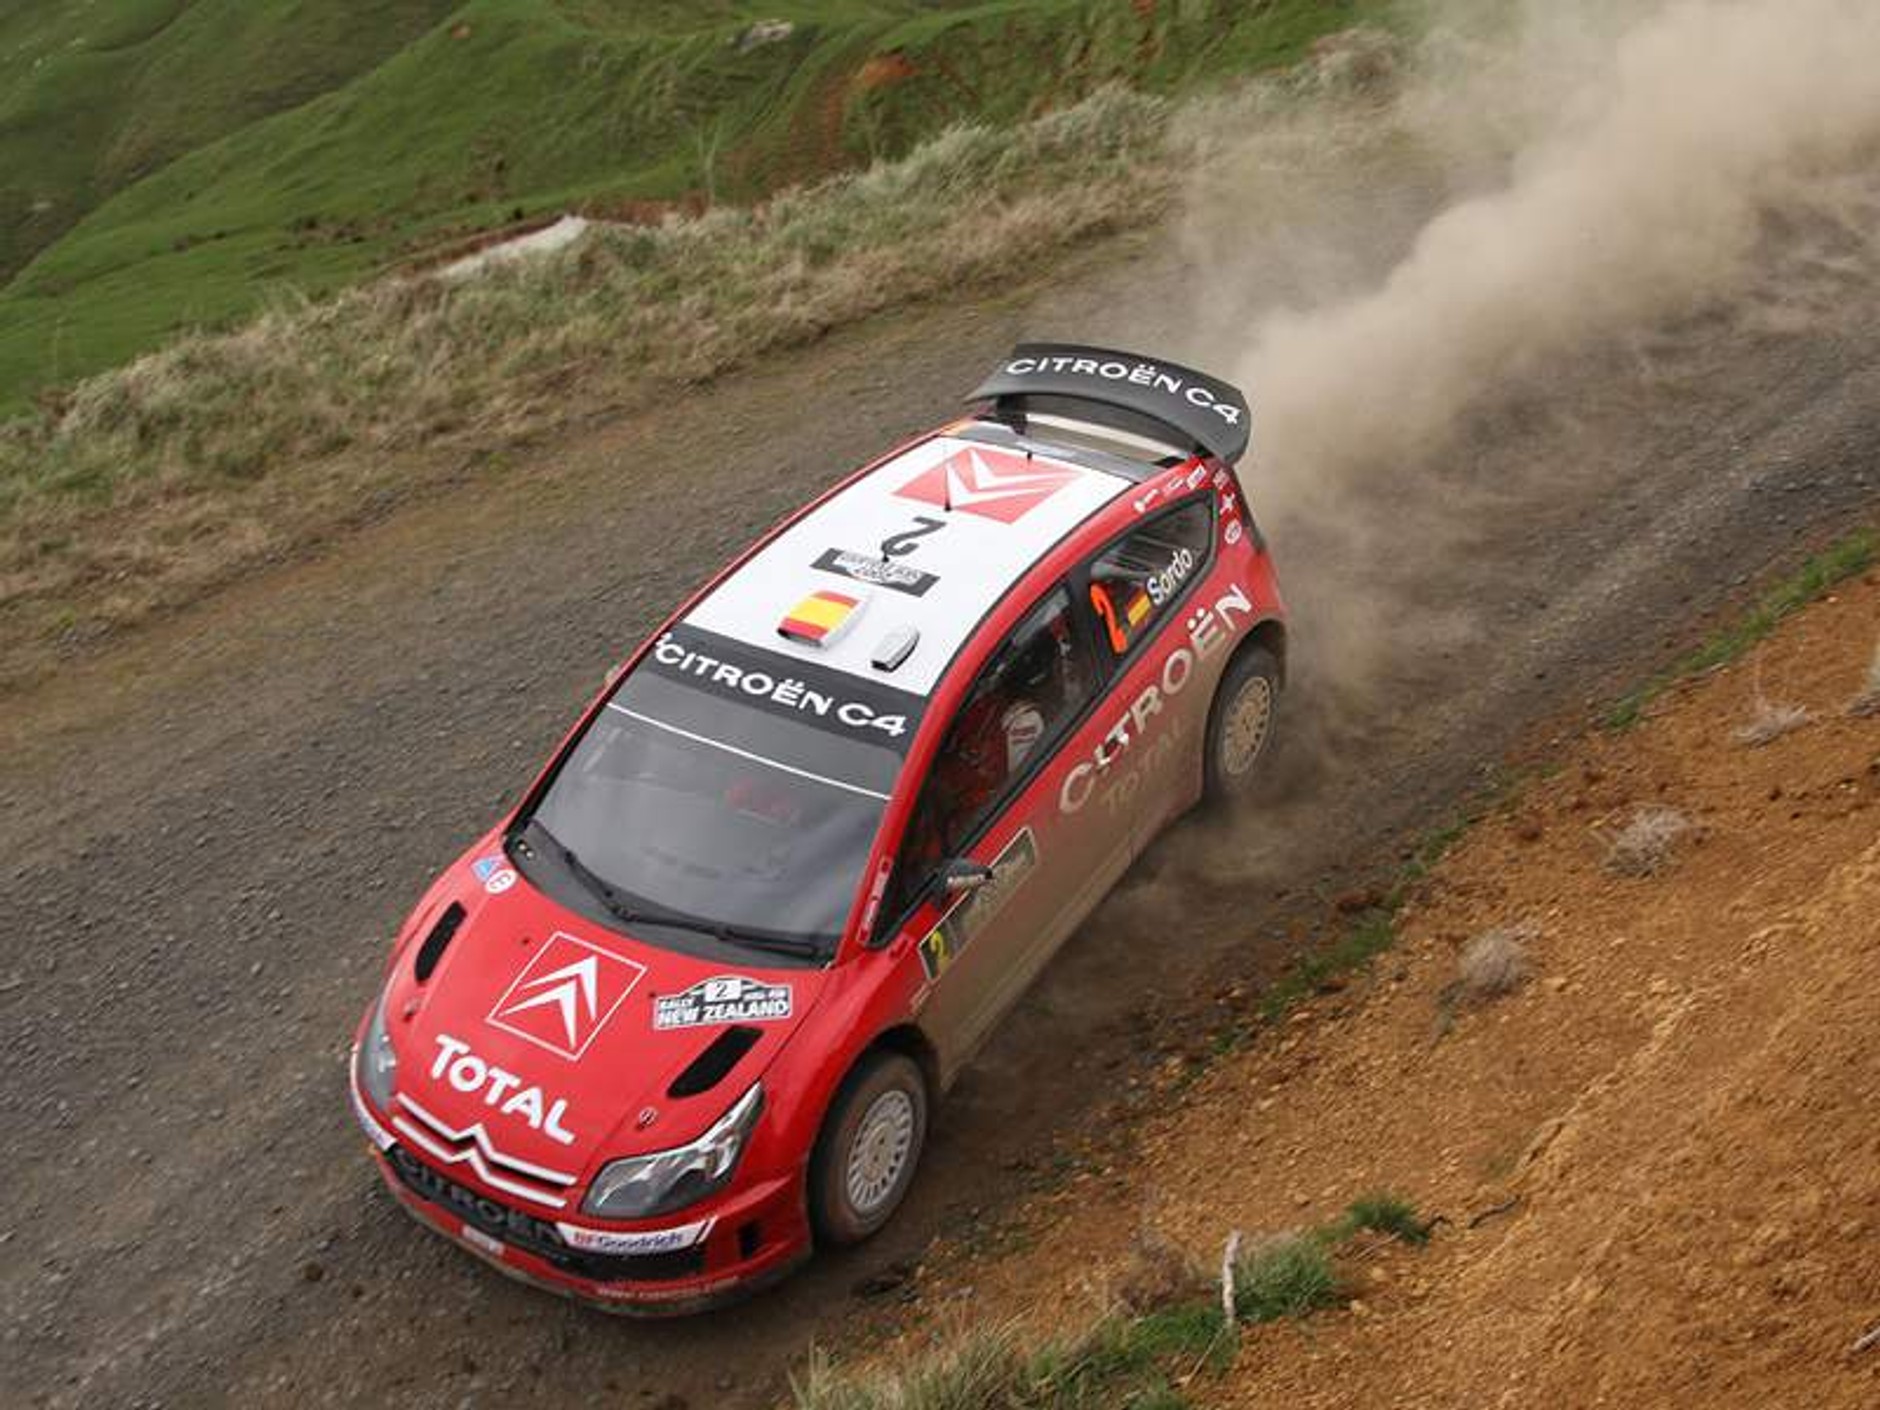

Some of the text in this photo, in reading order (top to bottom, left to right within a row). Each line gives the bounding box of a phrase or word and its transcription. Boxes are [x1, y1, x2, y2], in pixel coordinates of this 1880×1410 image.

[1006, 357, 1242, 425] CITROËN C4
[1147, 548, 1194, 605] Sordo
[1090, 582, 1128, 654] 2
[655, 643, 908, 737] CITROËN C4
[658, 1000, 789, 1025] NEW ZEALAND
[714, 982, 729, 998] 2
[430, 1033, 577, 1146] TOTAL
